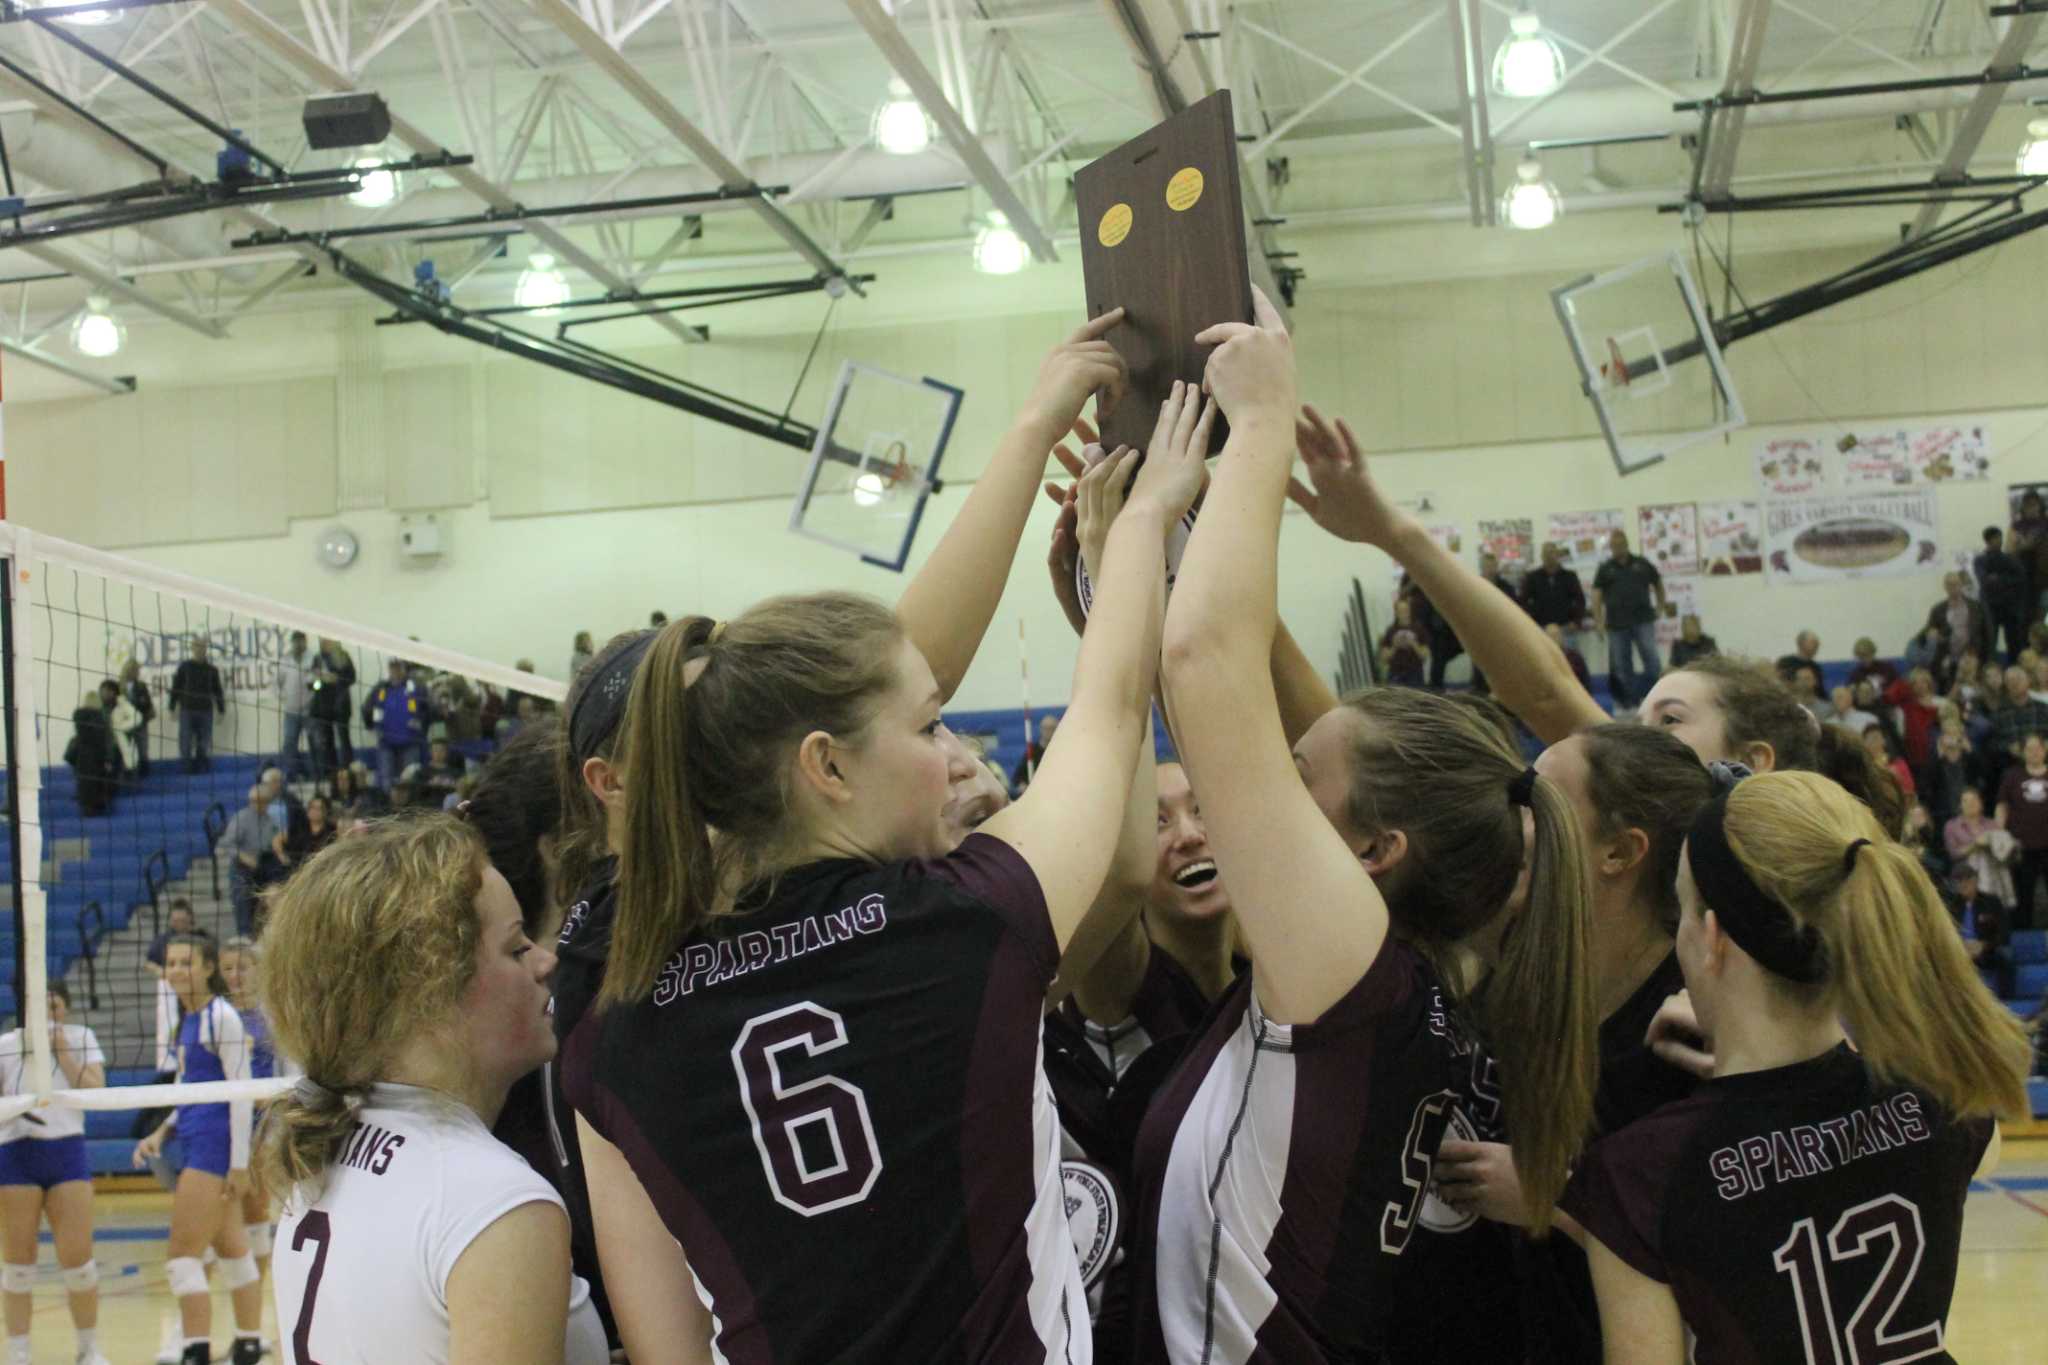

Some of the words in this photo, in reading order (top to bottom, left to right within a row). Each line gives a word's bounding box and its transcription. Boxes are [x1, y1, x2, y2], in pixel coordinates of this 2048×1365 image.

[339, 1121, 407, 1177] TANS
[730, 999, 884, 1217] 6
[1709, 1091, 1931, 1201] SPARTANS
[1772, 1192, 1945, 1365] 12
